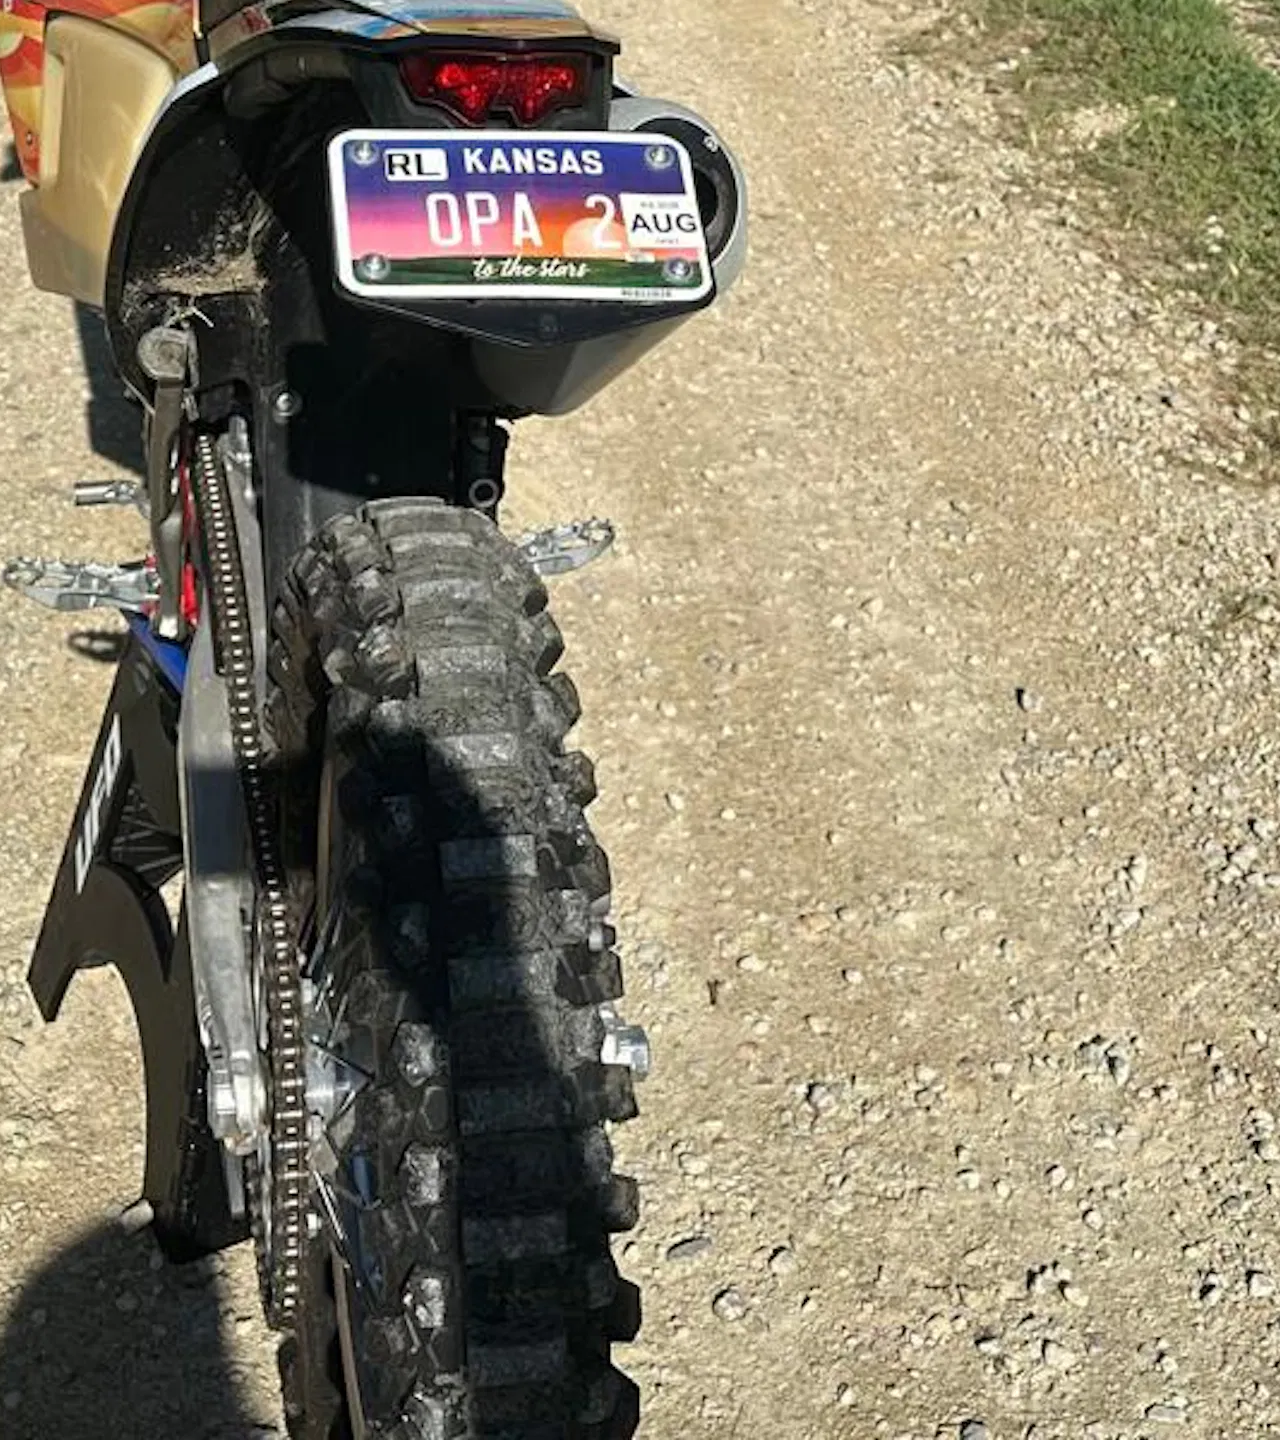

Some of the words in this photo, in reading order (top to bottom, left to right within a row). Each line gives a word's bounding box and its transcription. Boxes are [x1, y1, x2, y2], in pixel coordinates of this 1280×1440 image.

[388, 153, 441, 176] RL
[463, 147, 604, 175] KANSAS
[425, 191, 543, 248] OPA
[584, 193, 621, 250] 2
[631, 213, 697, 233] AUG
[472, 258, 498, 278] to
[499, 253, 537, 277] the
[539, 258, 589, 278] stars
[74, 712, 121, 895] UFO
